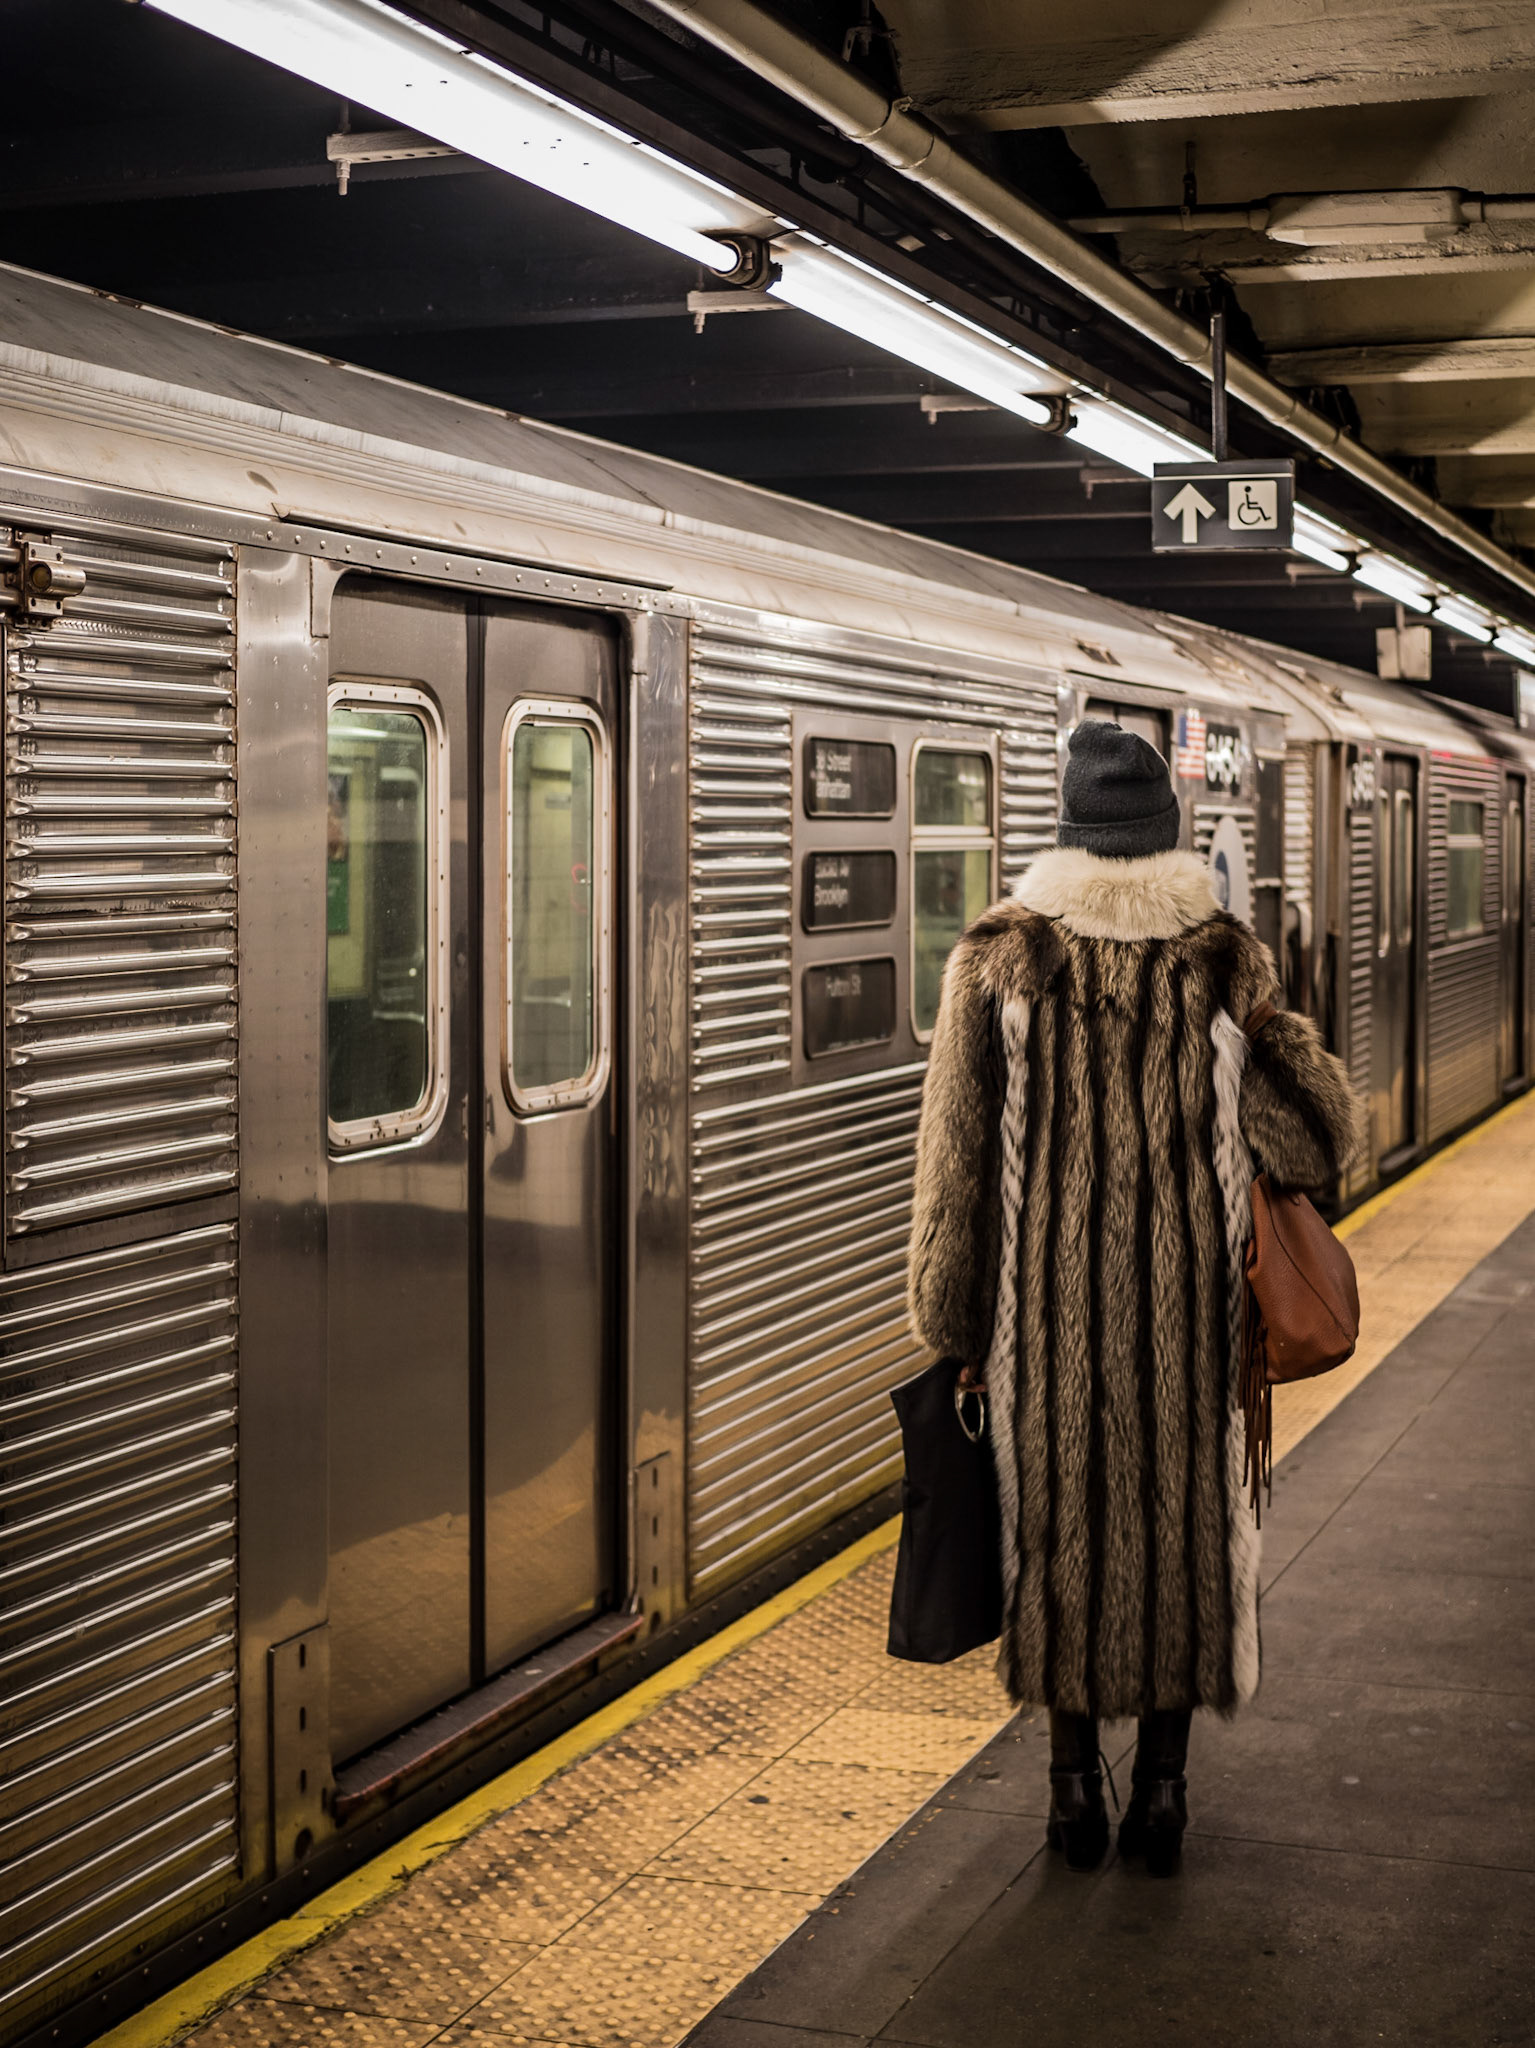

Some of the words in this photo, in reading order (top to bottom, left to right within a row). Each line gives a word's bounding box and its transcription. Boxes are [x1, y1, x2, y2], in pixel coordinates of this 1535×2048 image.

[827, 748, 852, 772] Street
[814, 882, 848, 908] Brooklyn
[825, 976, 849, 998] Fulton
